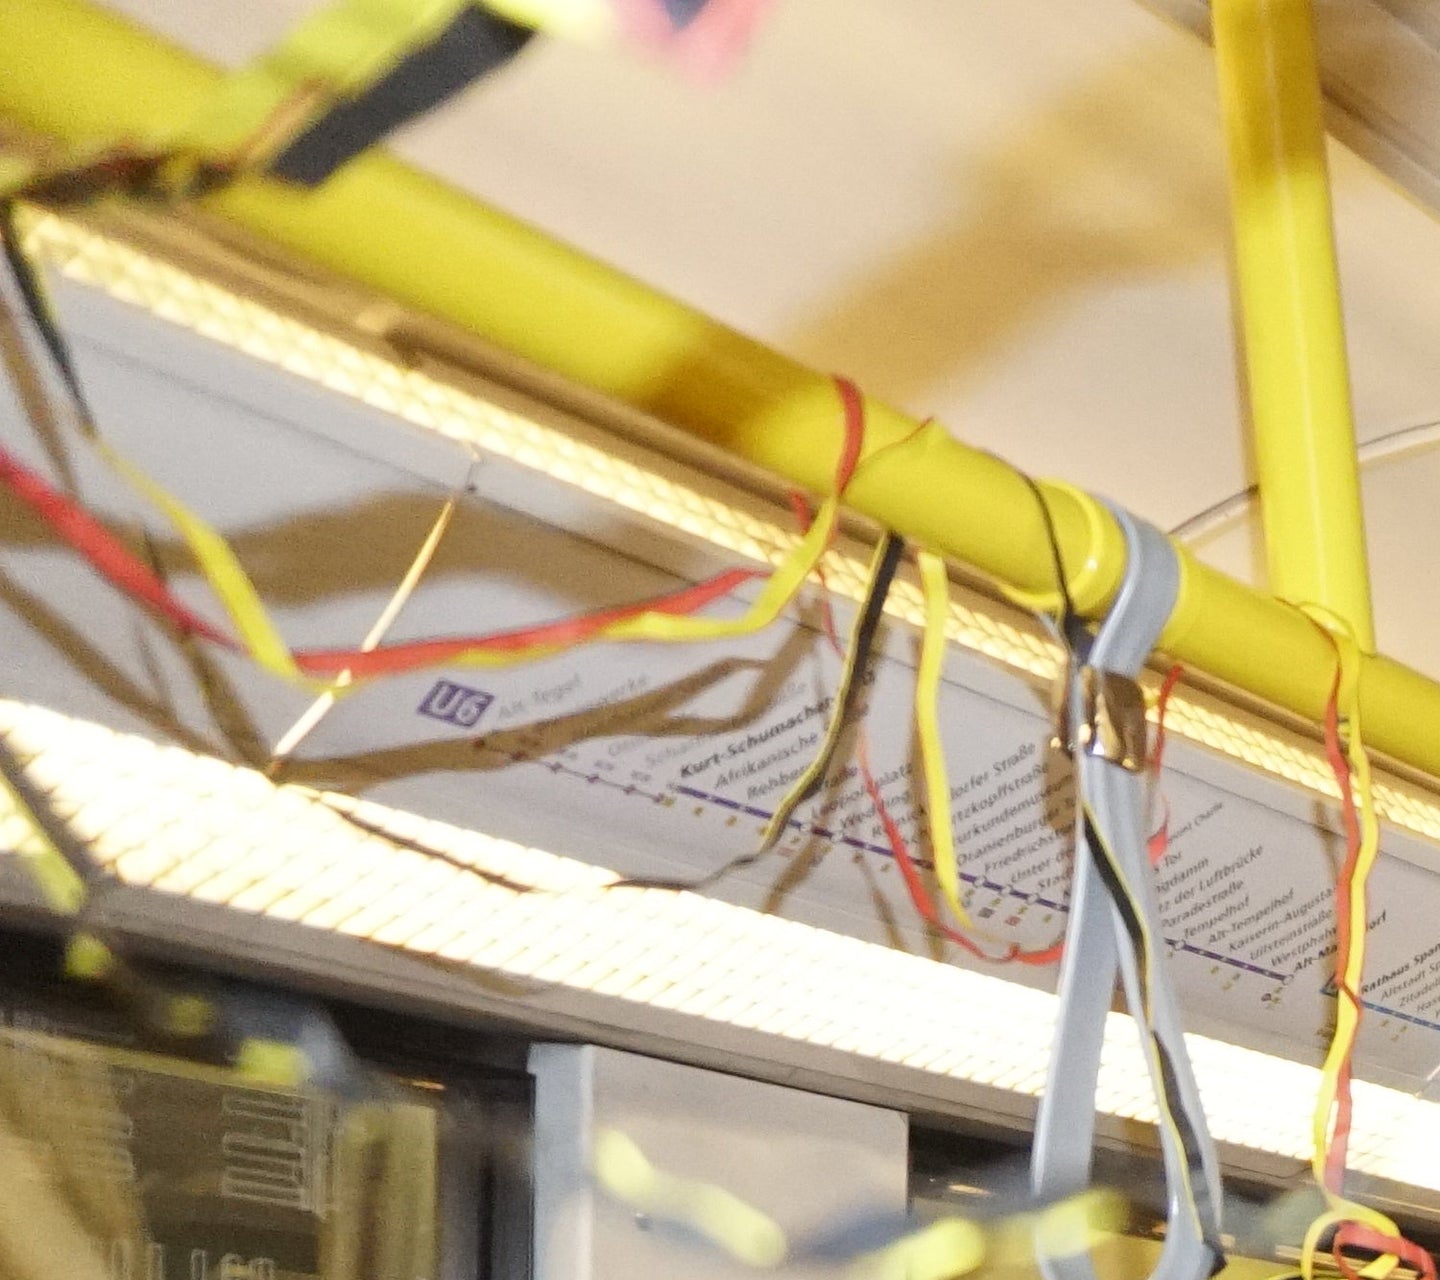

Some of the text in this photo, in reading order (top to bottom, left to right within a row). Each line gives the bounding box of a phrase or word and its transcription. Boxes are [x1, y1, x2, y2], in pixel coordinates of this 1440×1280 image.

[424, 682, 487, 725] U6
[993, 742, 1036, 772] Straße
[1198, 846, 1264, 892] Luftbrücke
[1183, 896, 1250, 940] Tempelhof
[1208, 888, 1294, 945] Alt-Tempelhof
[1361, 963, 1410, 994] Rathaus
